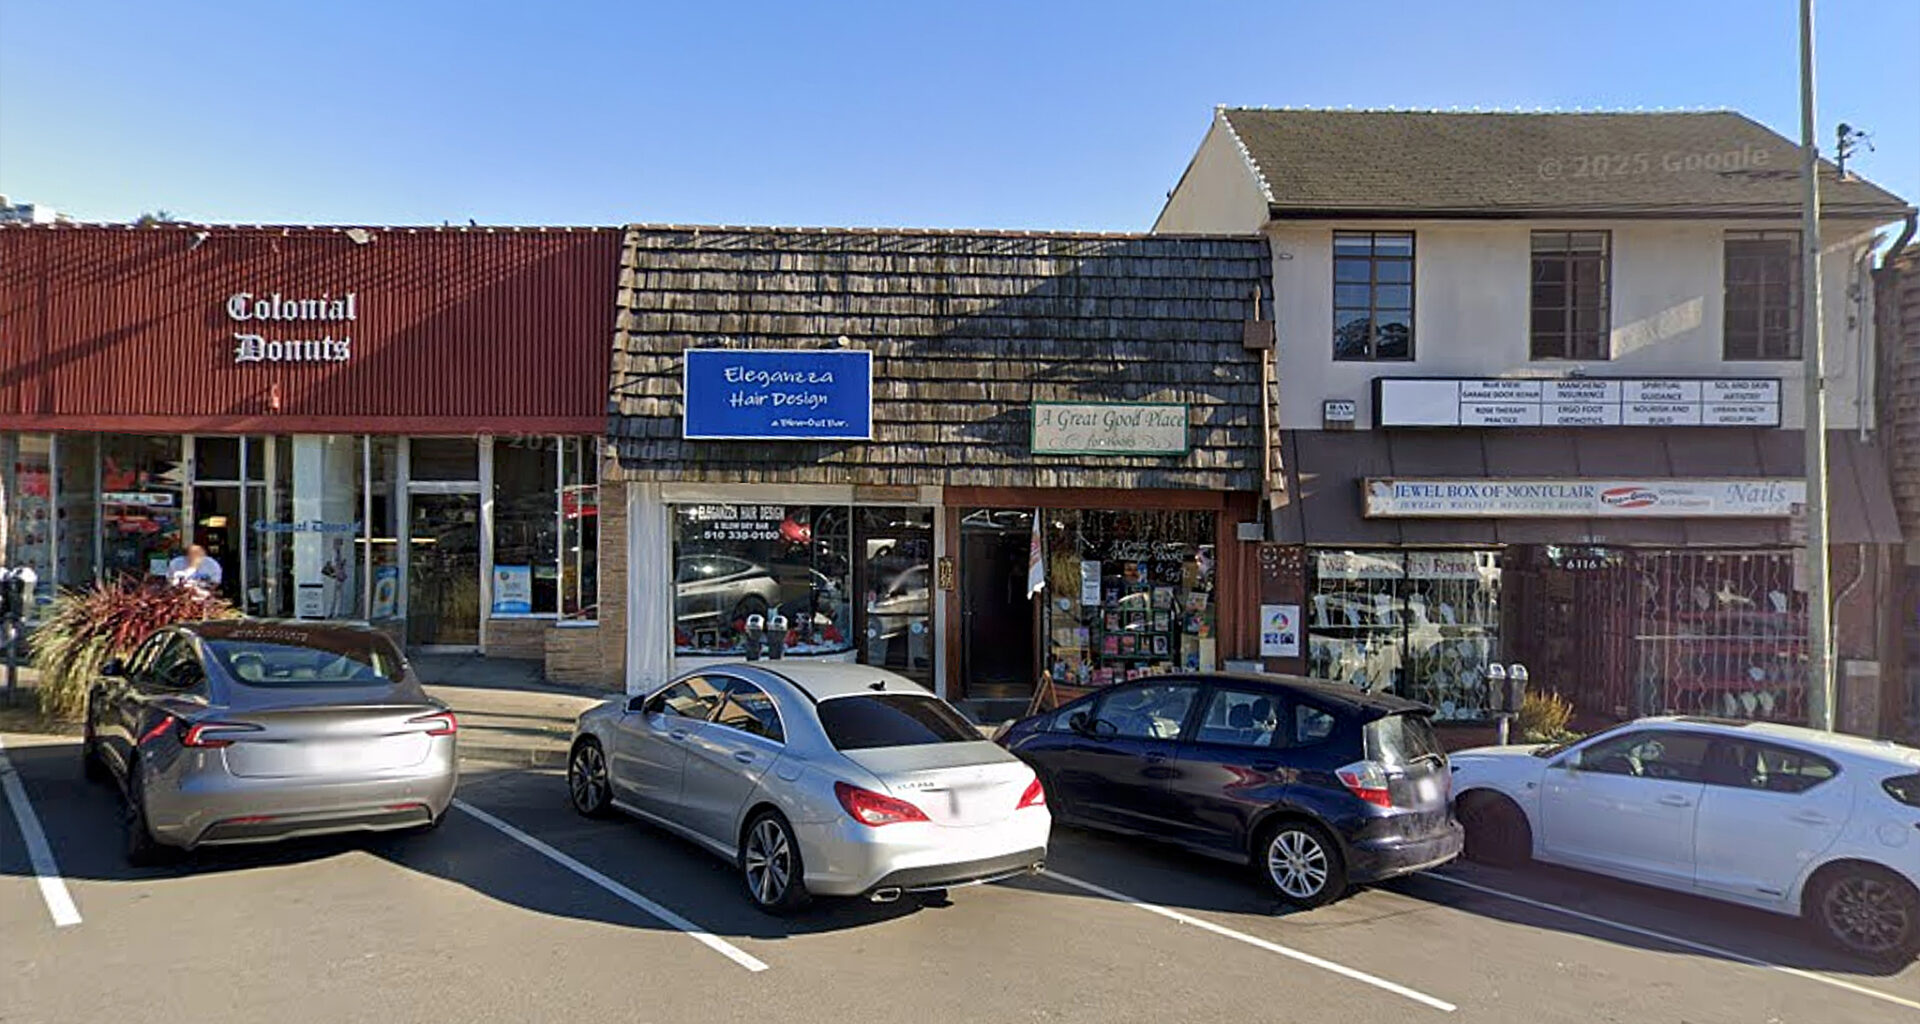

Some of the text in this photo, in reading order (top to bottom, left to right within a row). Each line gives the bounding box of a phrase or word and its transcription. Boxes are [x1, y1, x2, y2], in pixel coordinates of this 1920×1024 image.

[227, 291, 356, 321] Colonial
[234, 332, 350, 363] Donuts
[1642, 381, 1681, 390] SPIRITUAL
[1558, 390, 1605, 399] INSURANCE
[1641, 392, 1682, 401] GUIDANCE
[729, 391, 828, 410] Hair Design
[1558, 405, 1603, 414] ERGO FOOT
[1670, 405, 1690, 413] AND
[1037, 408, 1184, 433] A Great Good Place
[1484, 416, 1518, 424] PRACTICE
[1393, 485, 1444, 498] JEWEL
[1448, 485, 1479, 498] BOX
[1482, 485, 1501, 498] OF
[1505, 485, 1594, 498] MONTCLAIR
[1725, 483, 1786, 505] Nails
[740, 505, 758, 520] HAIR
[760, 506, 785, 520] DESIGN
[703, 531, 725, 539] 510
[1567, 560, 1597, 569] 6116
